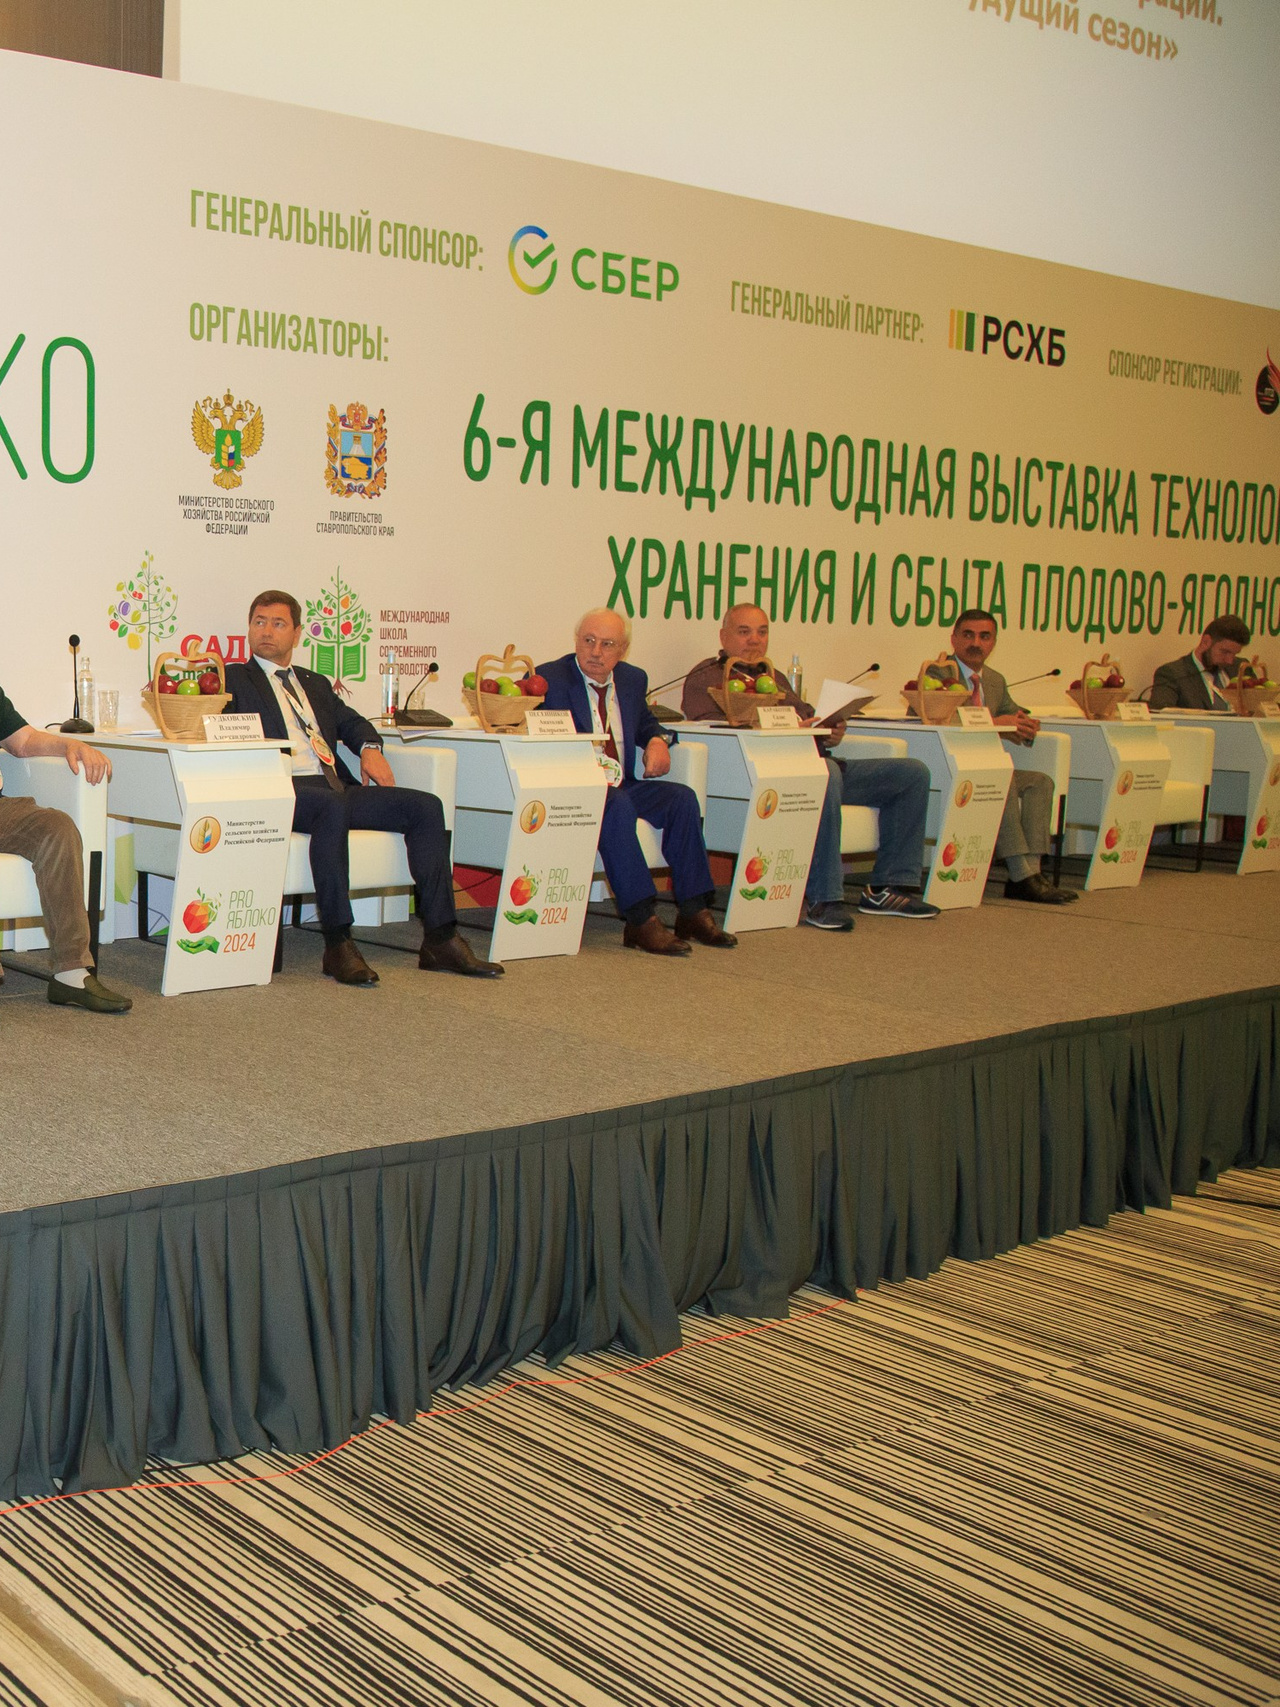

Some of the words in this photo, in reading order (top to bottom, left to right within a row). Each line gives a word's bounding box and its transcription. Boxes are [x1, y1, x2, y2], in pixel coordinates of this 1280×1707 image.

[1087, 13, 1178, 60] сезон»
[190, 189, 372, 255] ГЕНЕРАЛЬНЫЙ
[378, 221, 484, 272] СПОНСОР:
[571, 247, 680, 302] СБЕР
[730, 280, 850, 332] ГЕНЕРАЛЬНЫЙ
[854, 302, 924, 343] ПАРТНЕР:
[189, 302, 389, 362] ОРГАНИЗАТОРЫ:
[982, 315, 1066, 367] РСХБ
[1108, 349, 1161, 383] СПОНСОР
[1163, 358, 1243, 396] РЕГИСТРАЦИИ:
[463, 393, 551, 486] 6-Я
[572, 404, 956, 526] МЕЖДУНАРОДНАЯ
[969, 451, 1138, 535] ВЫСТАВКА
[1150, 472, 1280, 546] ТЕХНОЛО
[178, 495, 234, 508] МИНИСТЕРСТВО
[235, 498, 275, 511] СЕЛЬСКОГО
[182, 508, 223, 521] ХОЗЯЙСТВА
[224, 511, 271, 524] РОССИЙСКОЙ
[329, 511, 383, 524] ПРАВИТЕЛЬСТВО
[205, 523, 249, 536] ФЕДЕРАЦИИ
[316, 522, 378, 536] СТАВРОПОЛЬСКОГО
[378, 526, 395, 537] КРАЯ
[607, 535, 837, 625] ХРАНЕНИЯ
[851, 551, 876, 626] И
[890, 553, 1007, 630] СБЫТА
[380, 610, 450, 624] МЕЖДУНАРОДНАЯ
[380, 628, 408, 640] ШКОЛА
[548, 867, 568, 885] PRO
[229, 889, 254, 909] PRO
[545, 884, 586, 904] ЯБЛОКО
[226, 907, 276, 929] ЯБЛОКО
[540, 907, 568, 925] 2024
[223, 932, 256, 953] 2024
